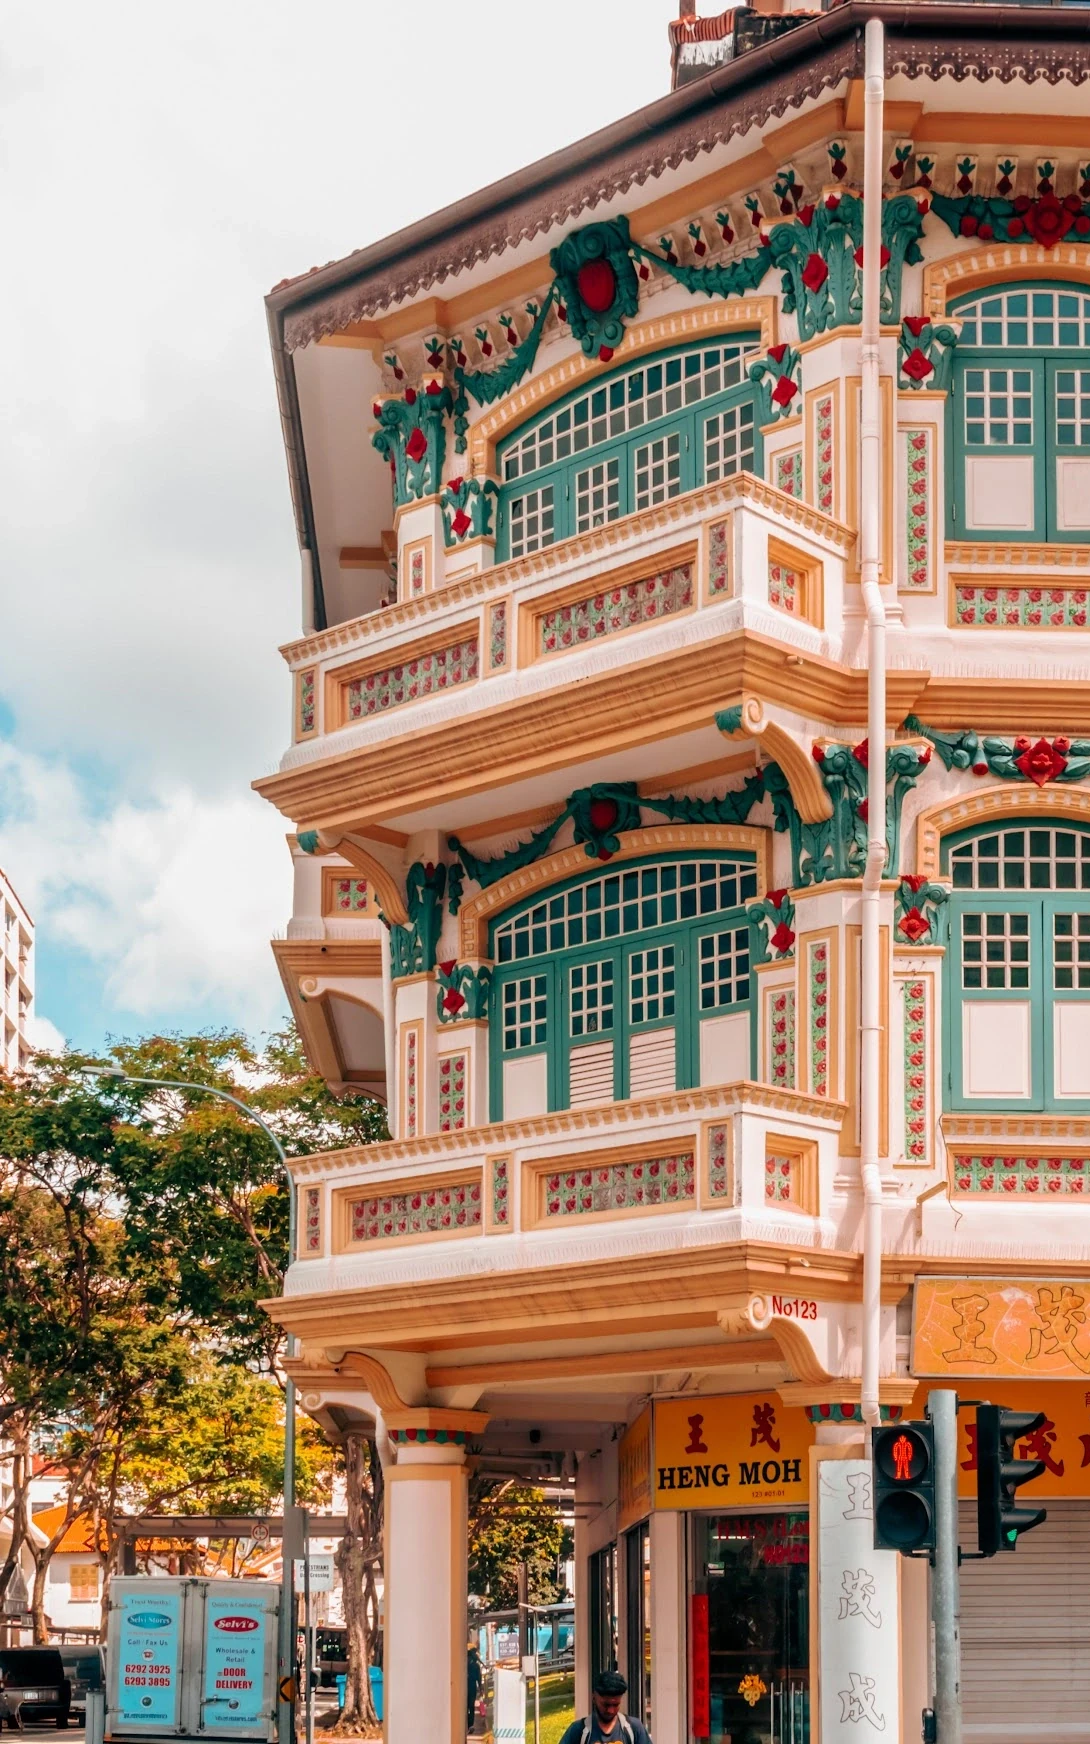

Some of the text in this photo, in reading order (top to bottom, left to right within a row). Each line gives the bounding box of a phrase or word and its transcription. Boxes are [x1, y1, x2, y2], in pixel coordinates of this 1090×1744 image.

[772, 1295, 818, 1320] No123
[657, 1458, 802, 1490] HENG MOH
[217, 1619, 254, 1629] Selvi's
[125, 1664, 171, 1675] 6292 3925
[223, 1668, 246, 1677] DOOR
[148, 1678, 171, 1687] 3895
[215, 1680, 253, 1689] DELIVERY
